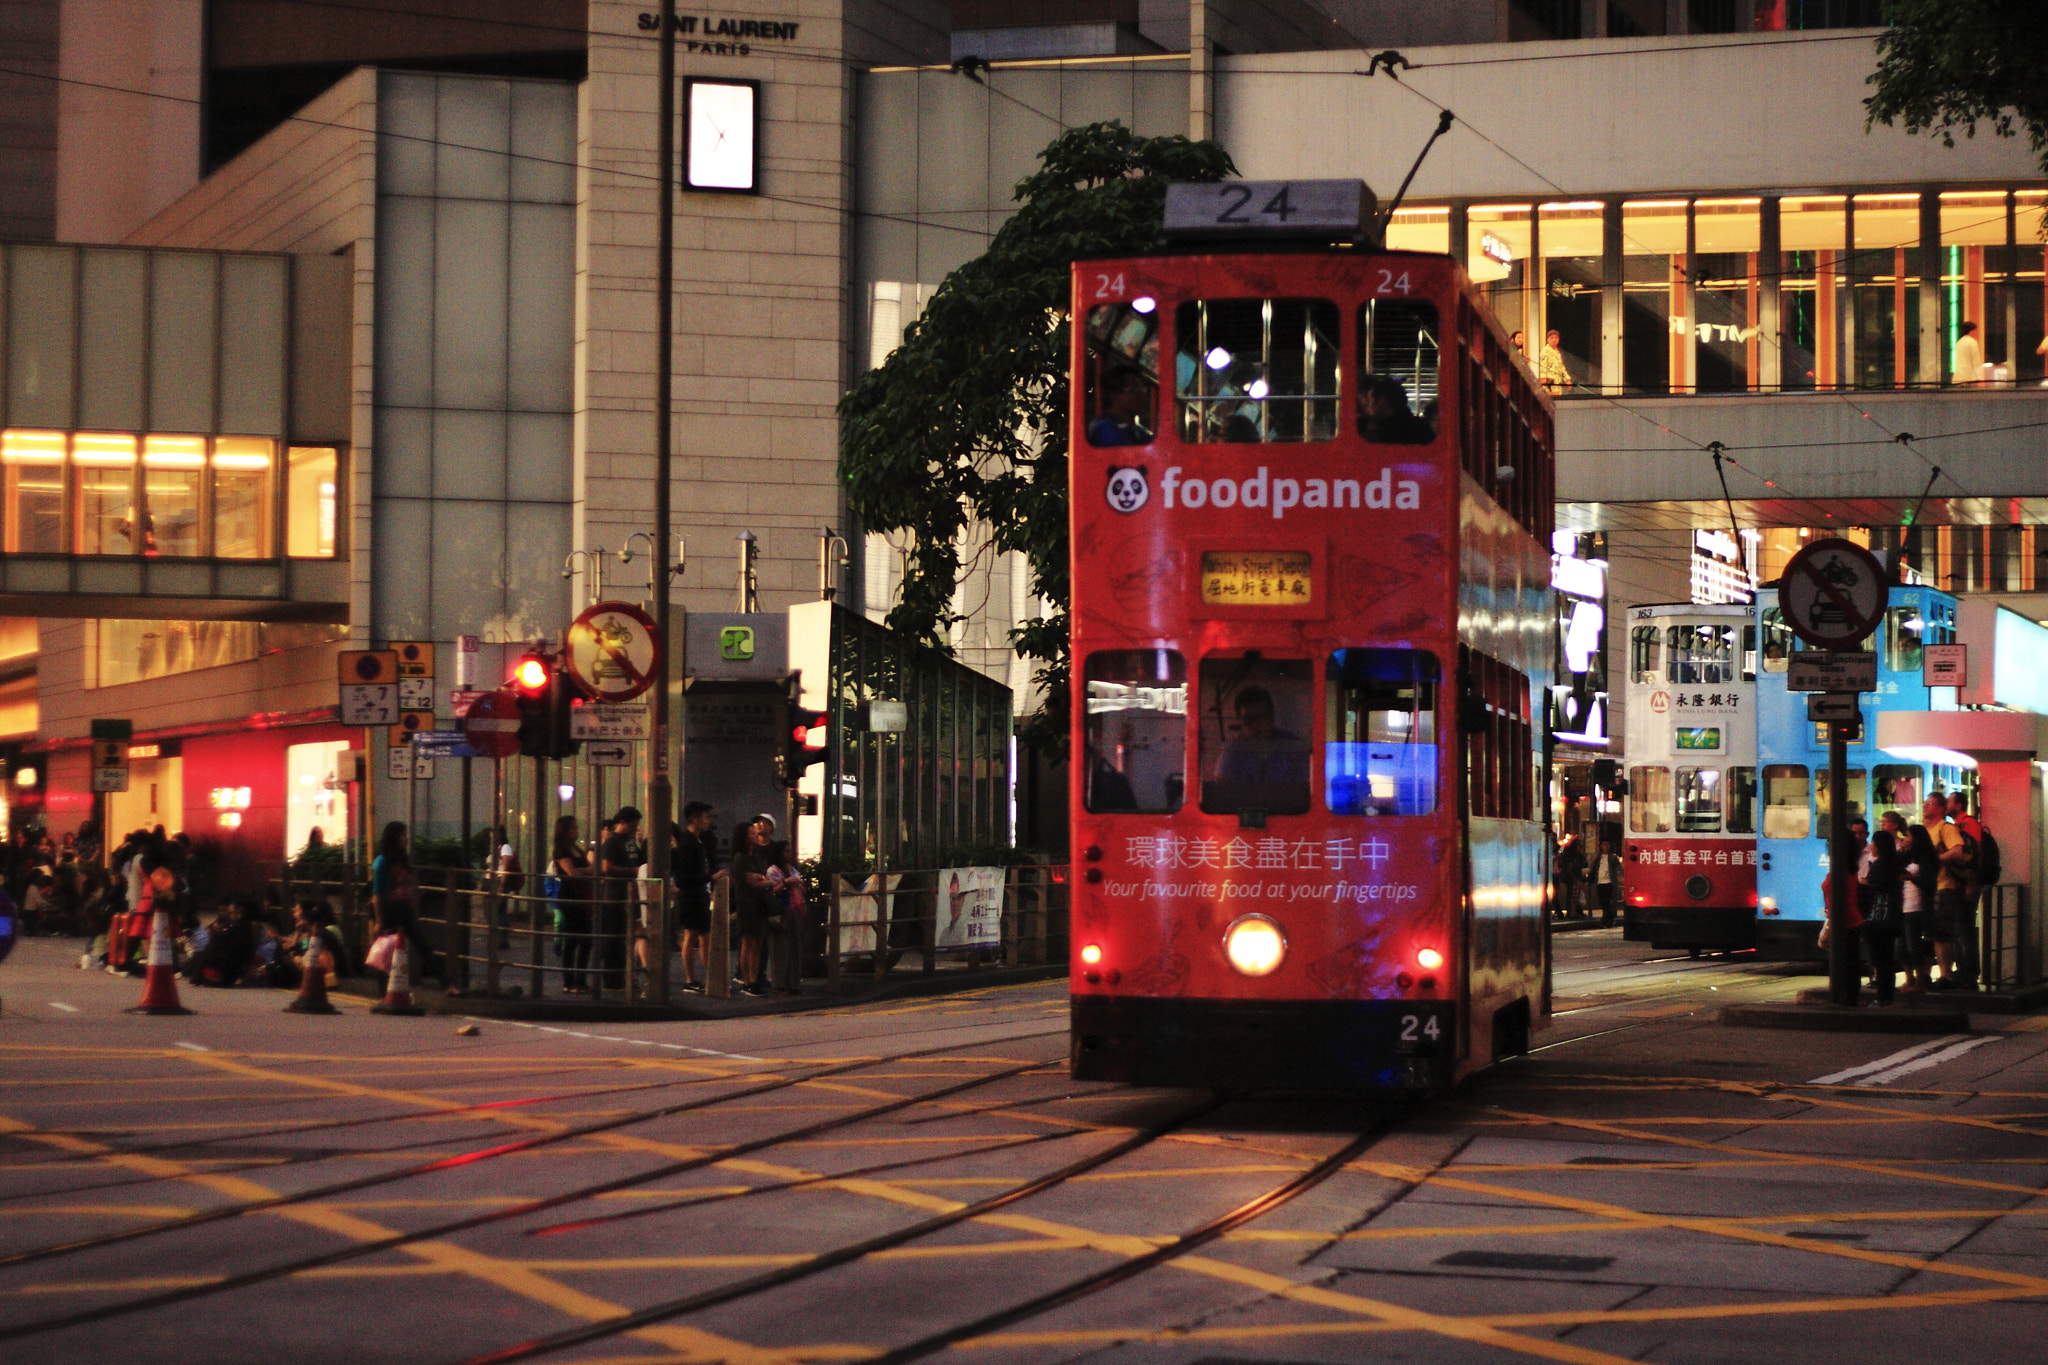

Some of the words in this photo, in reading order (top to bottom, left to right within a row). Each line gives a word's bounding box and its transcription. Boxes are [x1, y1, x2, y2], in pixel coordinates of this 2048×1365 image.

[638, 13, 698, 33] SANT
[703, 17, 799, 39] LAURENT
[688, 40, 750, 55] PARIS
[1217, 183, 1298, 223] 24
[1096, 273, 1126, 298] 24
[1377, 269, 1410, 294] 24
[1160, 466, 1420, 518] foodpanda
[1904, 593, 1920, 604] 62
[1637, 608, 1653, 619] 163
[378, 687, 388, 700] 7
[1676, 693, 1739, 707] 永隆銀行
[379, 708, 389, 720] 7
[1125, 836, 1389, 870] 環球美食盡在手中
[1103, 880, 1138, 897] Your
[1140, 879, 1216, 901] favourite
[1219, 879, 1263, 902] food
[1267, 882, 1285, 898] at
[1287, 884, 1332, 902] your
[1332, 881, 1417, 903] fingertips
[1401, 1014, 1440, 1040] 24
